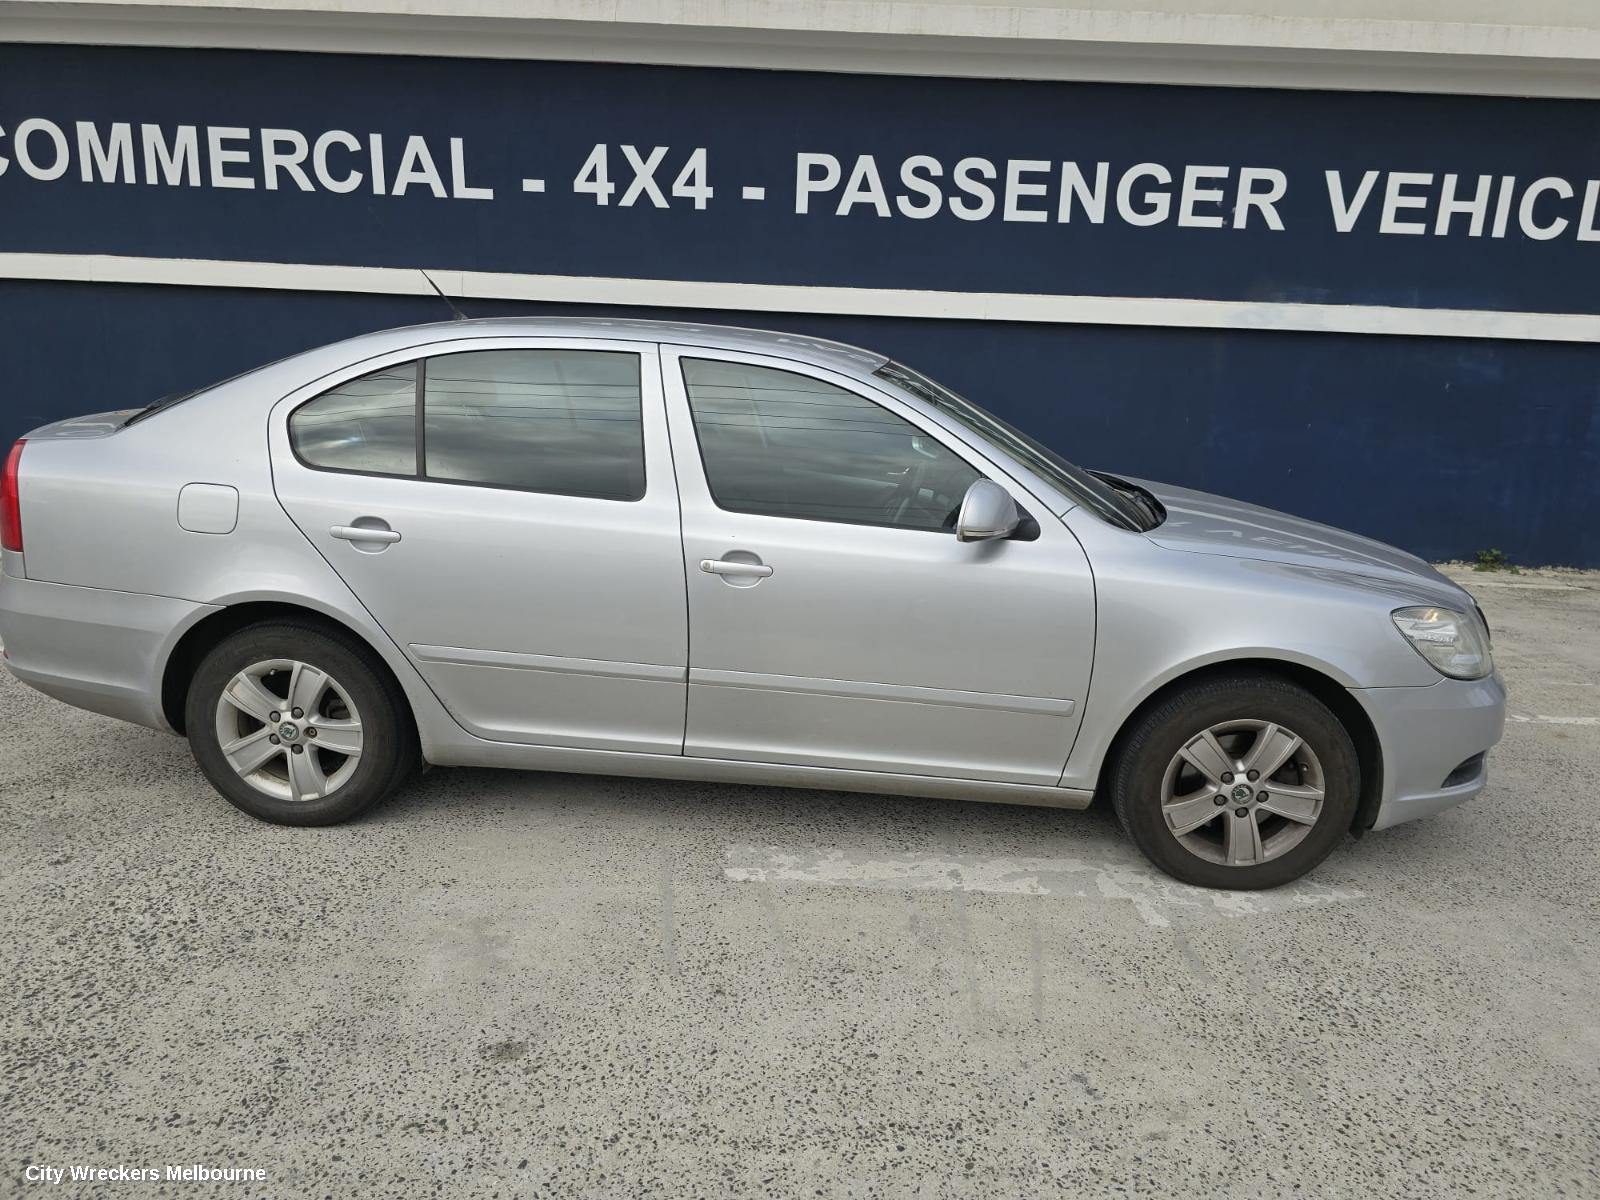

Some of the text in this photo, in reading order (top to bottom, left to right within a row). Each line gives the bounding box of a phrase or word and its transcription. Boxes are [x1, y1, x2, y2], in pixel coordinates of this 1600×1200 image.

[0, 117, 494, 200] OMMERCIAL
[573, 143, 714, 210] 4X4
[795, 152, 1288, 231] PASSENGER
[1325, 170, 1600, 242] VEHICL
